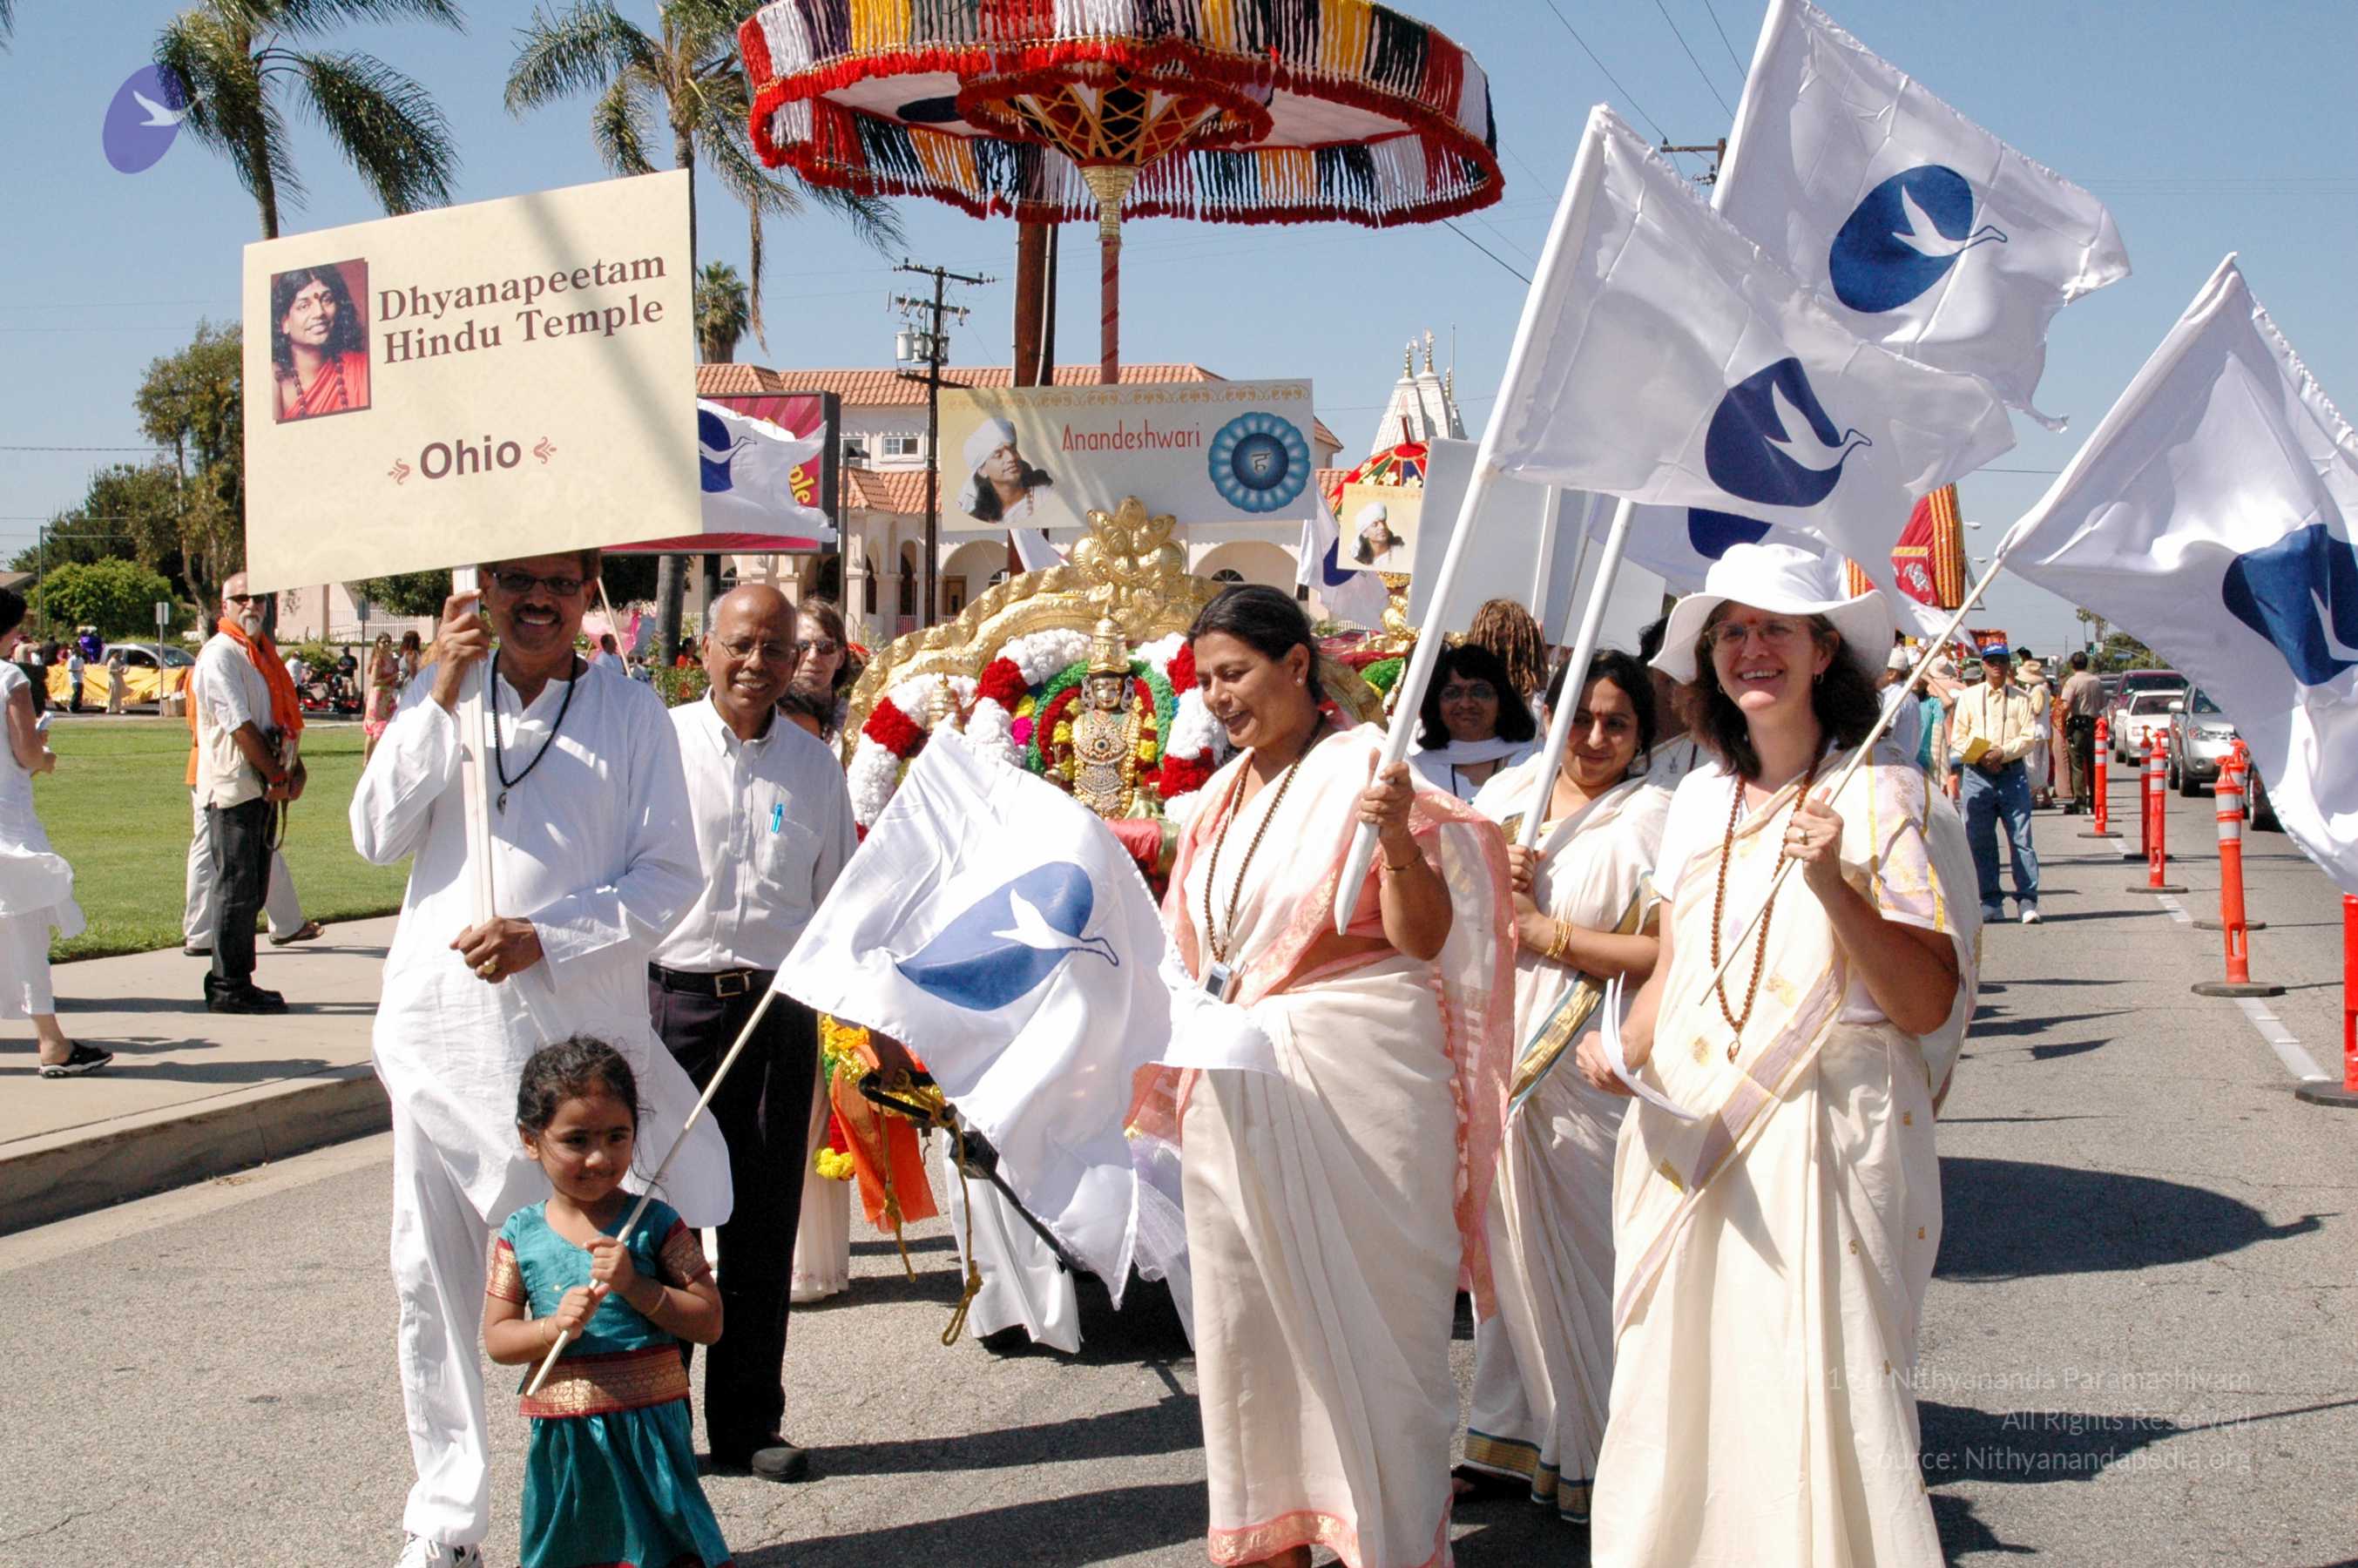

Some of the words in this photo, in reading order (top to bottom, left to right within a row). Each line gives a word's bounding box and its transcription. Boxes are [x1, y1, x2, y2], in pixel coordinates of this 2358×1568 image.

[378, 256, 666, 321] Dhyanapeetam
[383, 319, 502, 364] Hindu
[516, 294, 664, 341] Temple
[420, 435, 522, 480] Ohio
[1062, 419, 1201, 451] Anandeshwari
